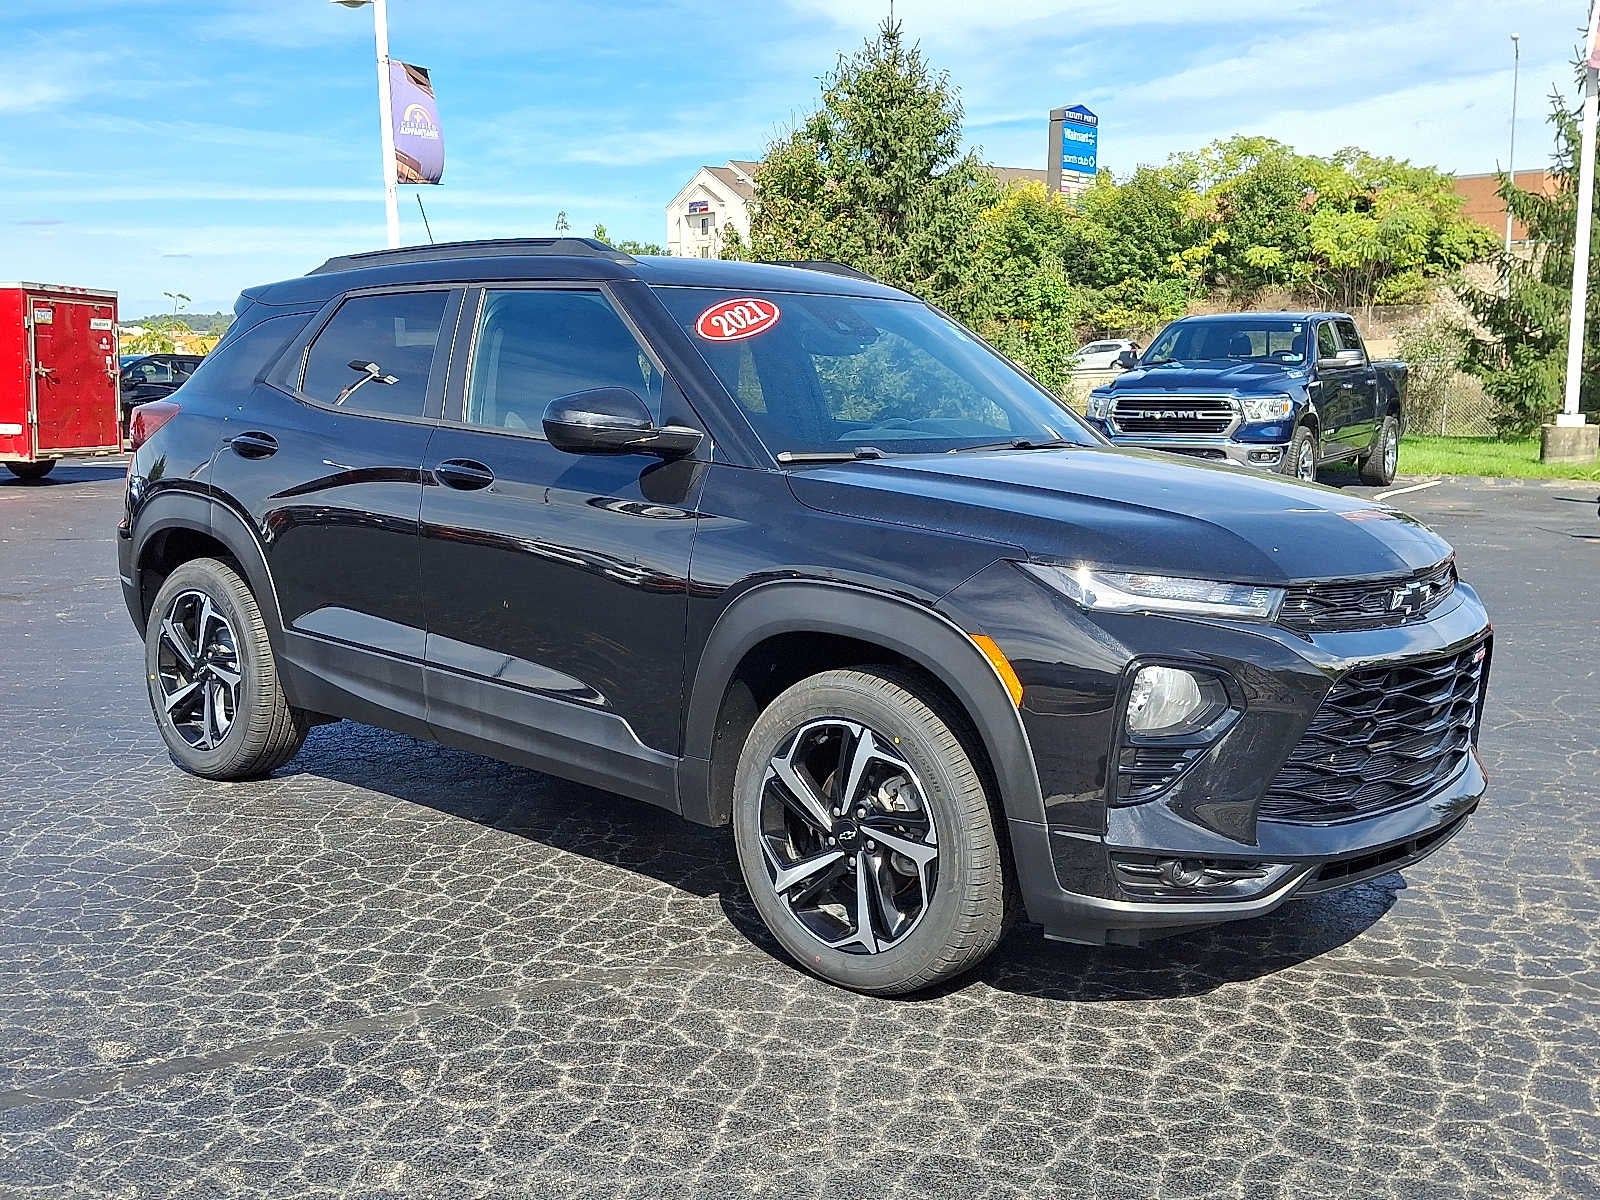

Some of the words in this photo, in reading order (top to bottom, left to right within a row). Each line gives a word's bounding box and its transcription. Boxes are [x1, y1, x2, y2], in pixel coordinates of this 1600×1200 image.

[1064, 127, 1089, 144] Walmart
[711, 301, 771, 337] 2021
[1144, 410, 1195, 419] RAM
